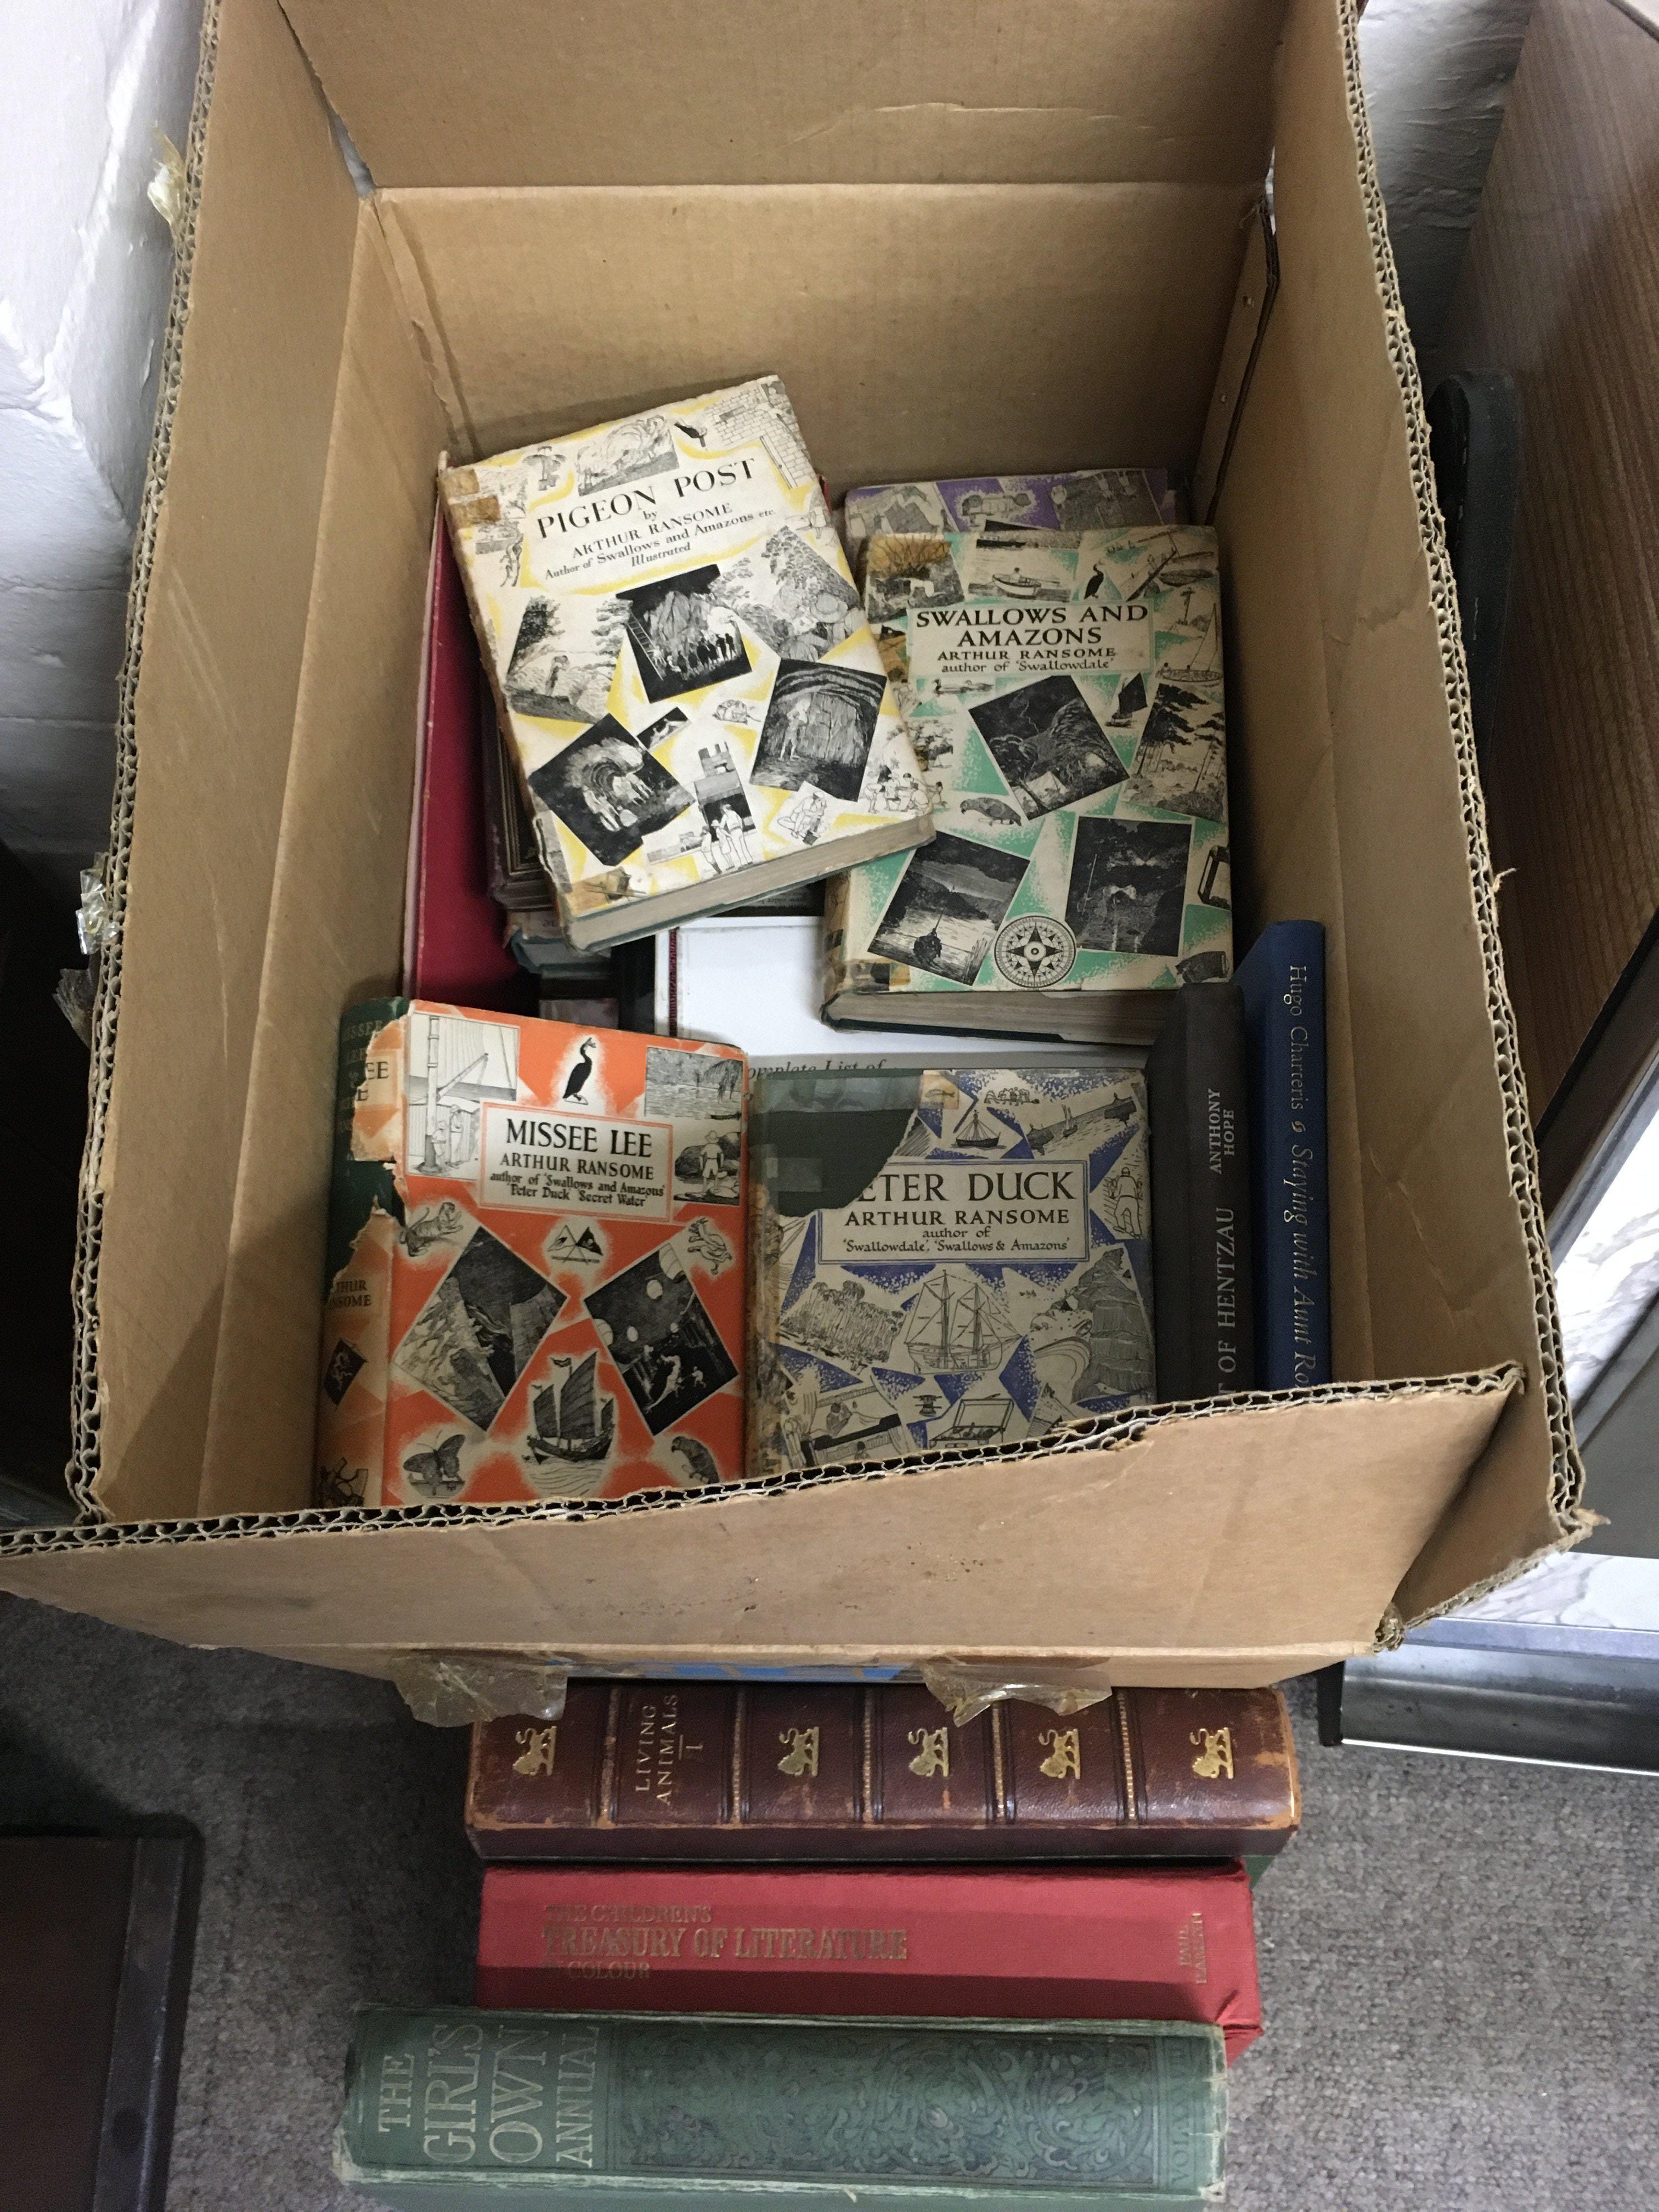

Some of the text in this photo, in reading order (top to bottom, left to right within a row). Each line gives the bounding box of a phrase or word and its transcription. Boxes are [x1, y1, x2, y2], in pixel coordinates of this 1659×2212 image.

[537, 458, 755, 539] PIGEON POST
[643, 511, 657, 521] by
[545, 563, 579, 580] Author
[582, 558, 593, 569] of
[596, 540, 661, 565] Swallows
[665, 529, 690, 543] and
[694, 512, 754, 535] Amazons
[572, 503, 732, 558] ARTHUR RANSOME
[631, 542, 691, 567] Illustrated
[916, 605, 1148, 628] SWALLOWS AND
[957, 627, 1102, 647] AMAZONS
[937, 648, 1116, 661] ARTHUR RANSOME
[941, 662, 987, 673] author
[994, 661, 1009, 672] of
[1283, 965, 1307, 1017] Hugo
[1290, 1026, 1310, 1110] Charteris
[506, 1118, 652, 1158] MISSEE LEE
[1207, 1088, 1222, 1174] ANTHONY
[1223, 1109, 1235, 1156] HOPE
[490, 1171, 522, 1183] author
[528, 1173, 540, 1184] of
[597, 1182, 617, 1193] and
[500, 1153, 654, 1180] ARTHUR RANSOME
[968, 1171, 1077, 1201] DUCK
[1283, 1144, 1313, 1226] Staying
[844, 1209, 1070, 1226] ARTHUR RANSOME
[922, 1226, 991, 1238] author of
[996, 1241, 1005, 1251] &
[1216, 1207, 1236, 1328] HENTZAU
[1293, 1232, 1318, 1280] with
[1294, 1285, 1316, 1345] Aunt
[1217, 1339, 1236, 1373] OF
[635, 1704, 656, 1792] LIVING
[656, 1694, 679, 1806] ANIMALS
[541, 1926, 907, 1961] TREASURY OF LITERATURE
[567, 1960, 651, 1980] COLOUR
[378, 2053, 414, 2132] THE
[424, 2024, 483, 2163] GIRL'S
[489, 2025, 549, 2163] OWN
[556, 2026, 599, 2168] ANNUAL
